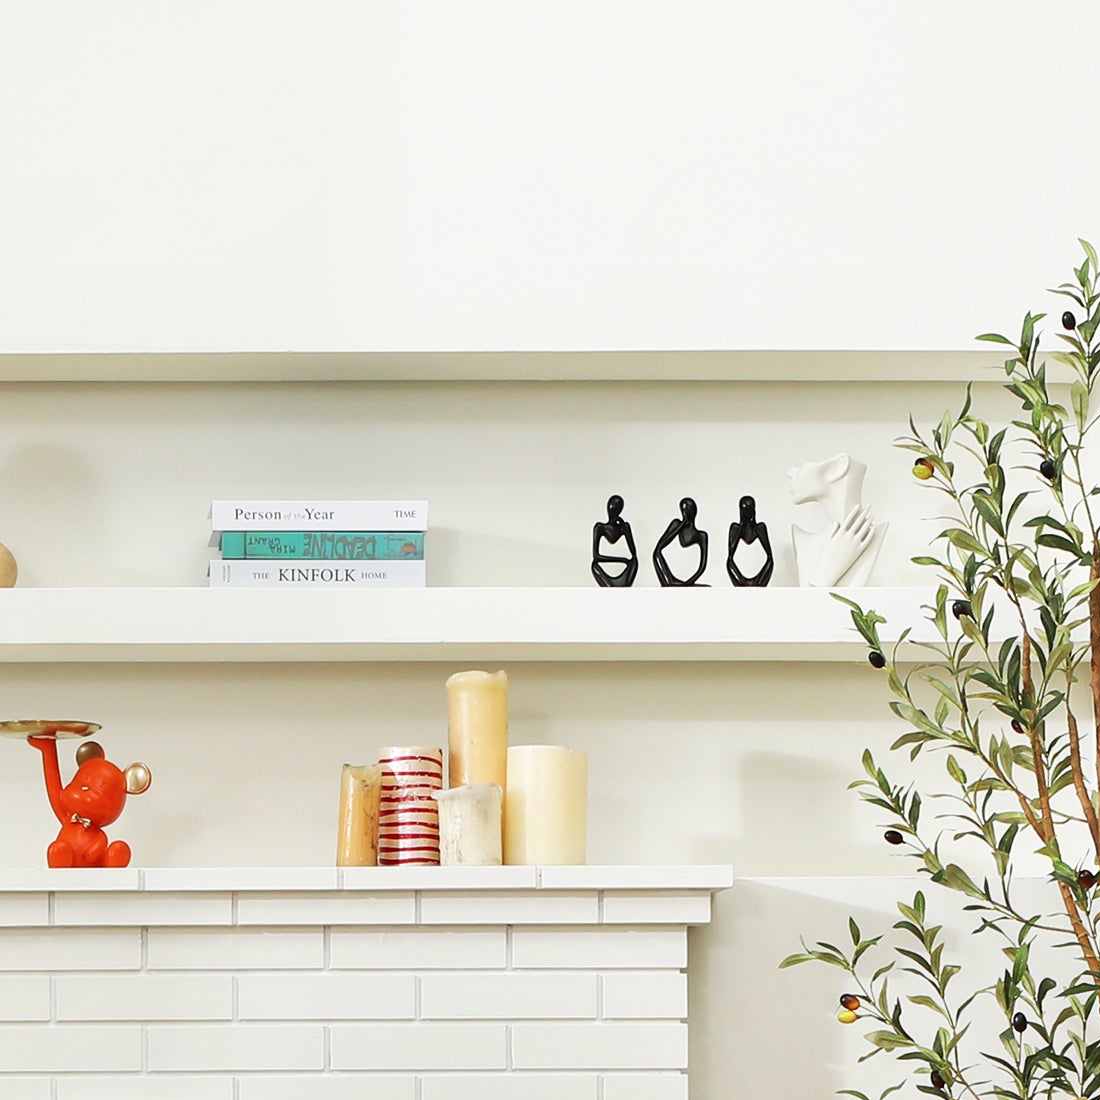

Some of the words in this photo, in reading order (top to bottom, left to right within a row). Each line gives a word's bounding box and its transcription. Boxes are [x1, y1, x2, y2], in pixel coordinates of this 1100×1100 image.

[234, 508, 282, 521] Person
[283, 511, 292, 522] of
[293, 512, 304, 521] the
[304, 508, 335, 521] Year
[394, 510, 417, 519] TIME
[247, 537, 281, 548] GRANT
[269, 545, 296, 554] MIRA
[302, 532, 377, 559] DEADLINE
[252, 572, 270, 580] THE
[278, 568, 357, 583] KINFOLK
[361, 571, 388, 580] HOME
